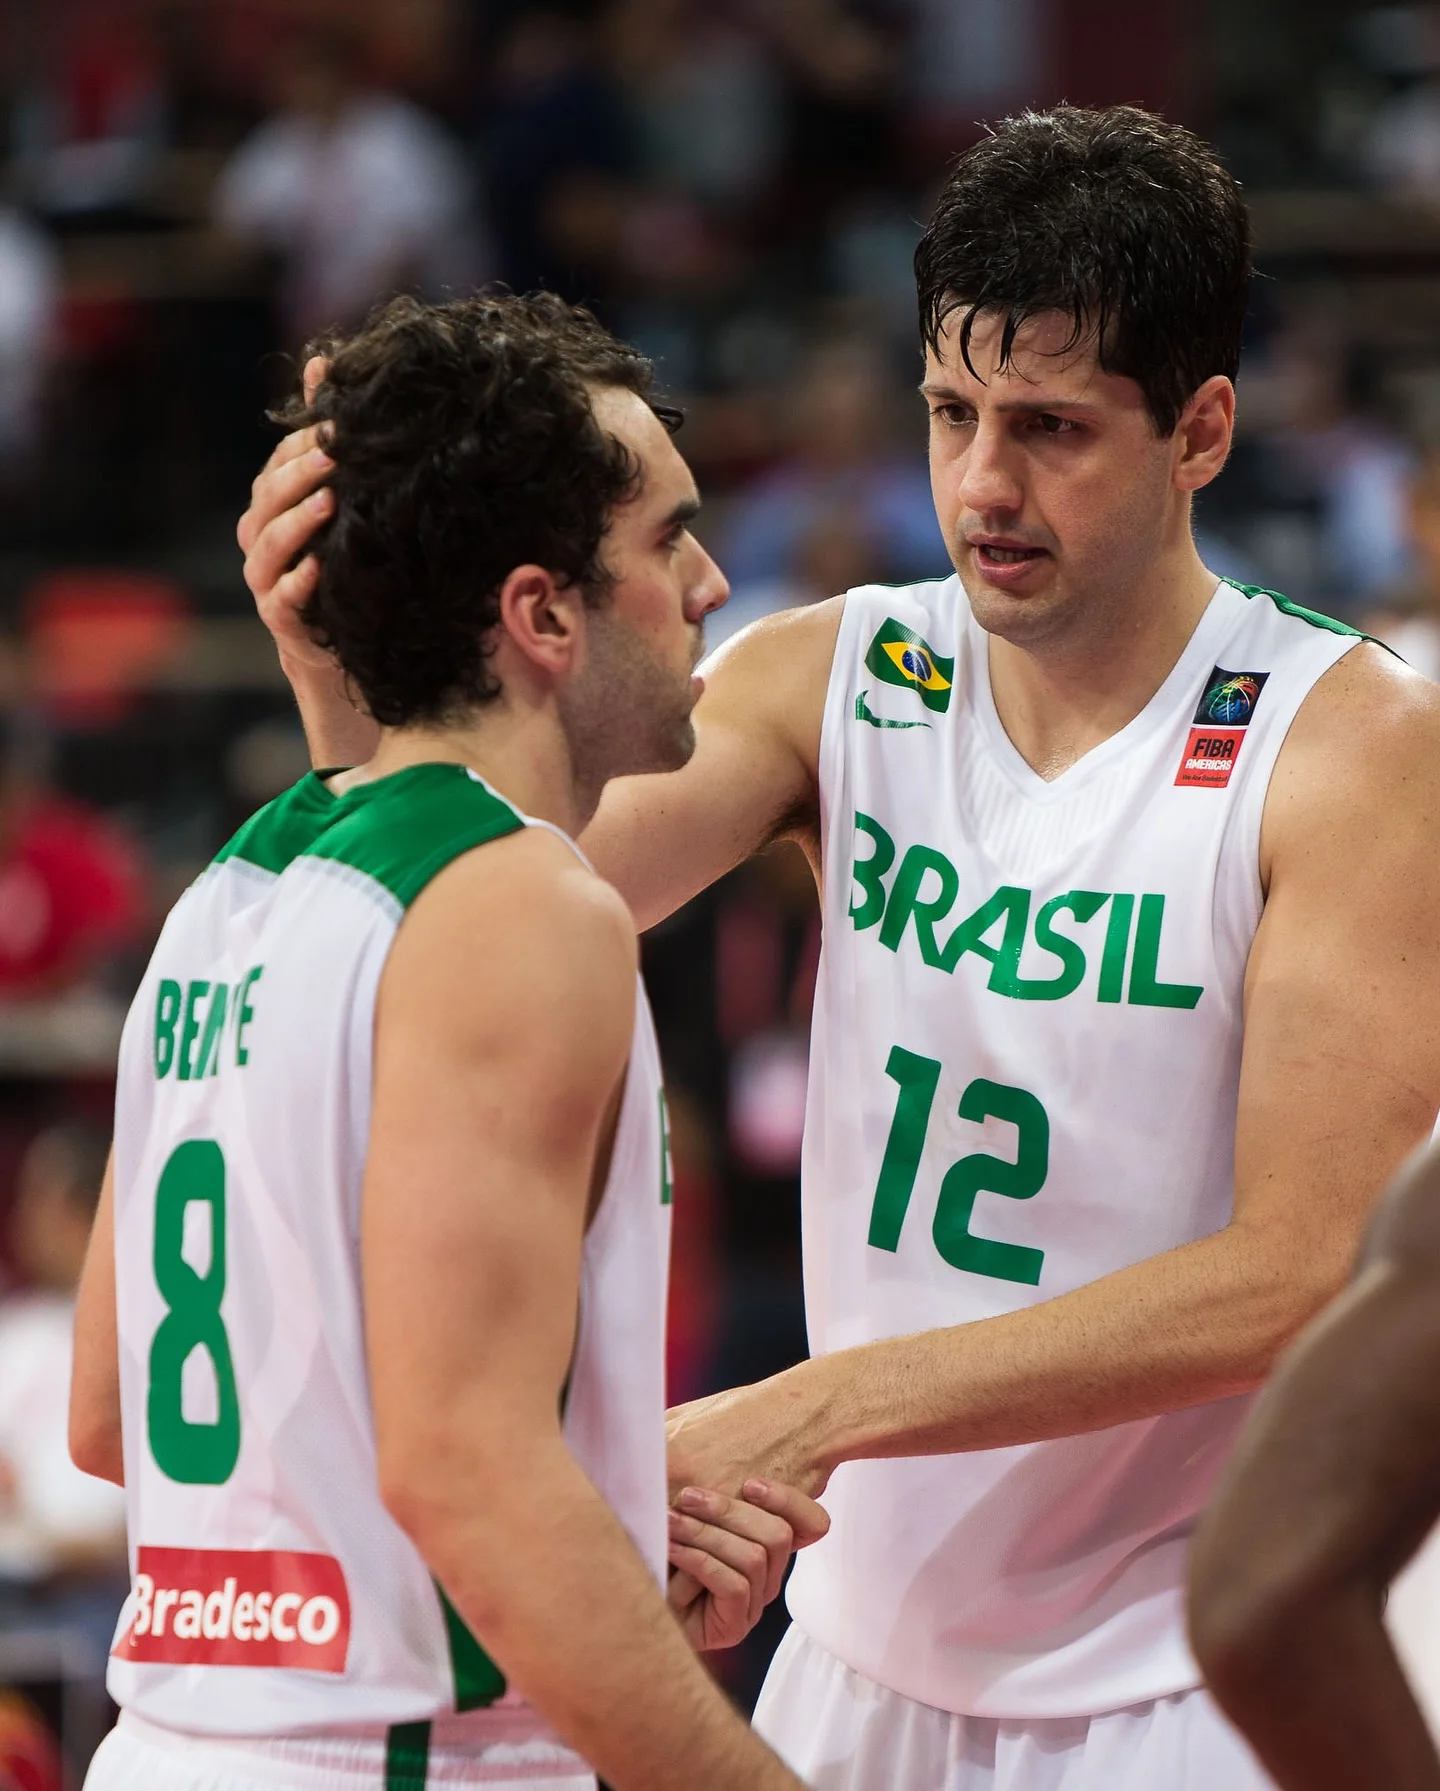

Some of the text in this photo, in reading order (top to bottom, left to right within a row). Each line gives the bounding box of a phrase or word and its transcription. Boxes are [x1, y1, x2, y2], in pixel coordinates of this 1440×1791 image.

[1185, 758, 1232, 771] AMERICAS
[1193, 738, 1235, 758] FIBA
[848, 810, 1204, 1010] BRASIL
[868, 1045, 1050, 1286] 12
[147, 1139, 241, 1486] 8
[133, 1573, 340, 1646] Bradesco
